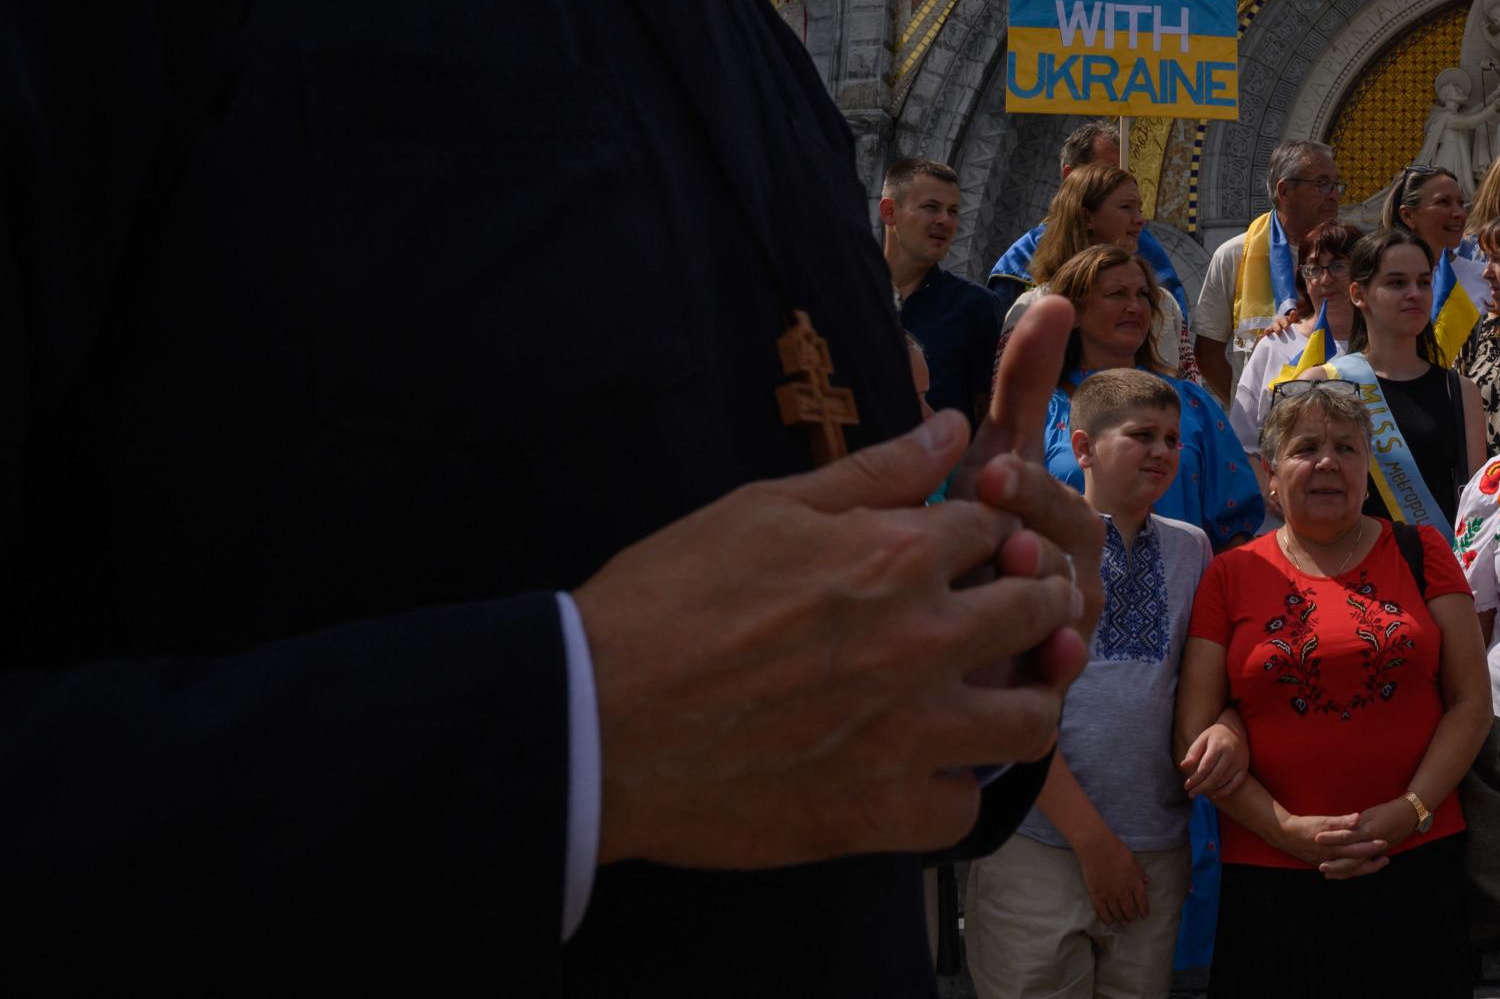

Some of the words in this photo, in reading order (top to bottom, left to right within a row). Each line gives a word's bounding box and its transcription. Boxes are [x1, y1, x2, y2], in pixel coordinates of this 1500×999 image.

[1056, 0, 1189, 52] WITH
[1007, 52, 1236, 107] UKRAINE
[1360, 383, 1402, 453] MISS
